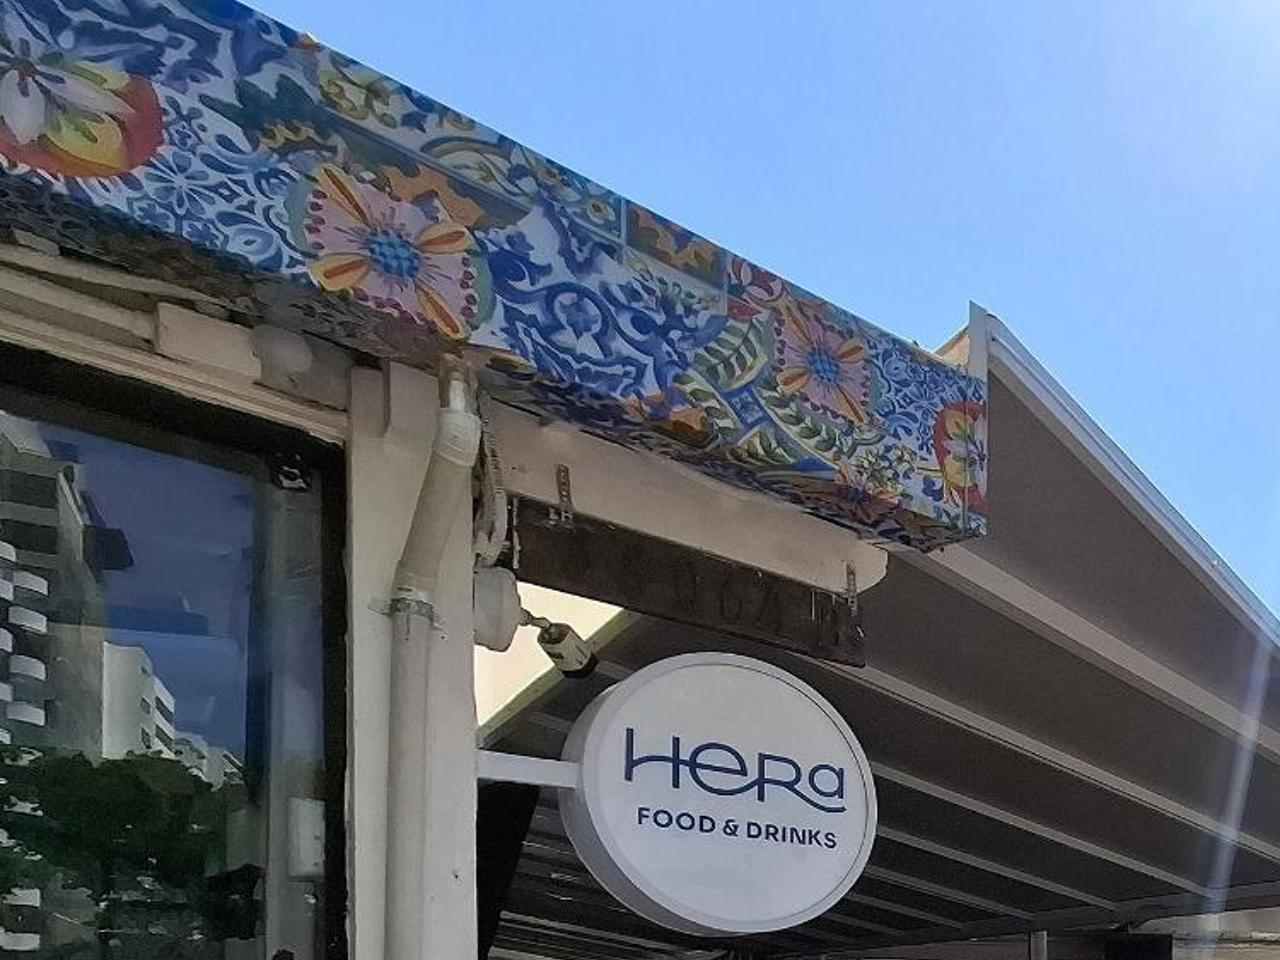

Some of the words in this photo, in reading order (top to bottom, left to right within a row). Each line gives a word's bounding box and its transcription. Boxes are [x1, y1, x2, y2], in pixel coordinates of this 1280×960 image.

[637, 807, 716, 833] FOOD
[723, 819, 739, 837] &
[746, 822, 837, 849] DRINKS
